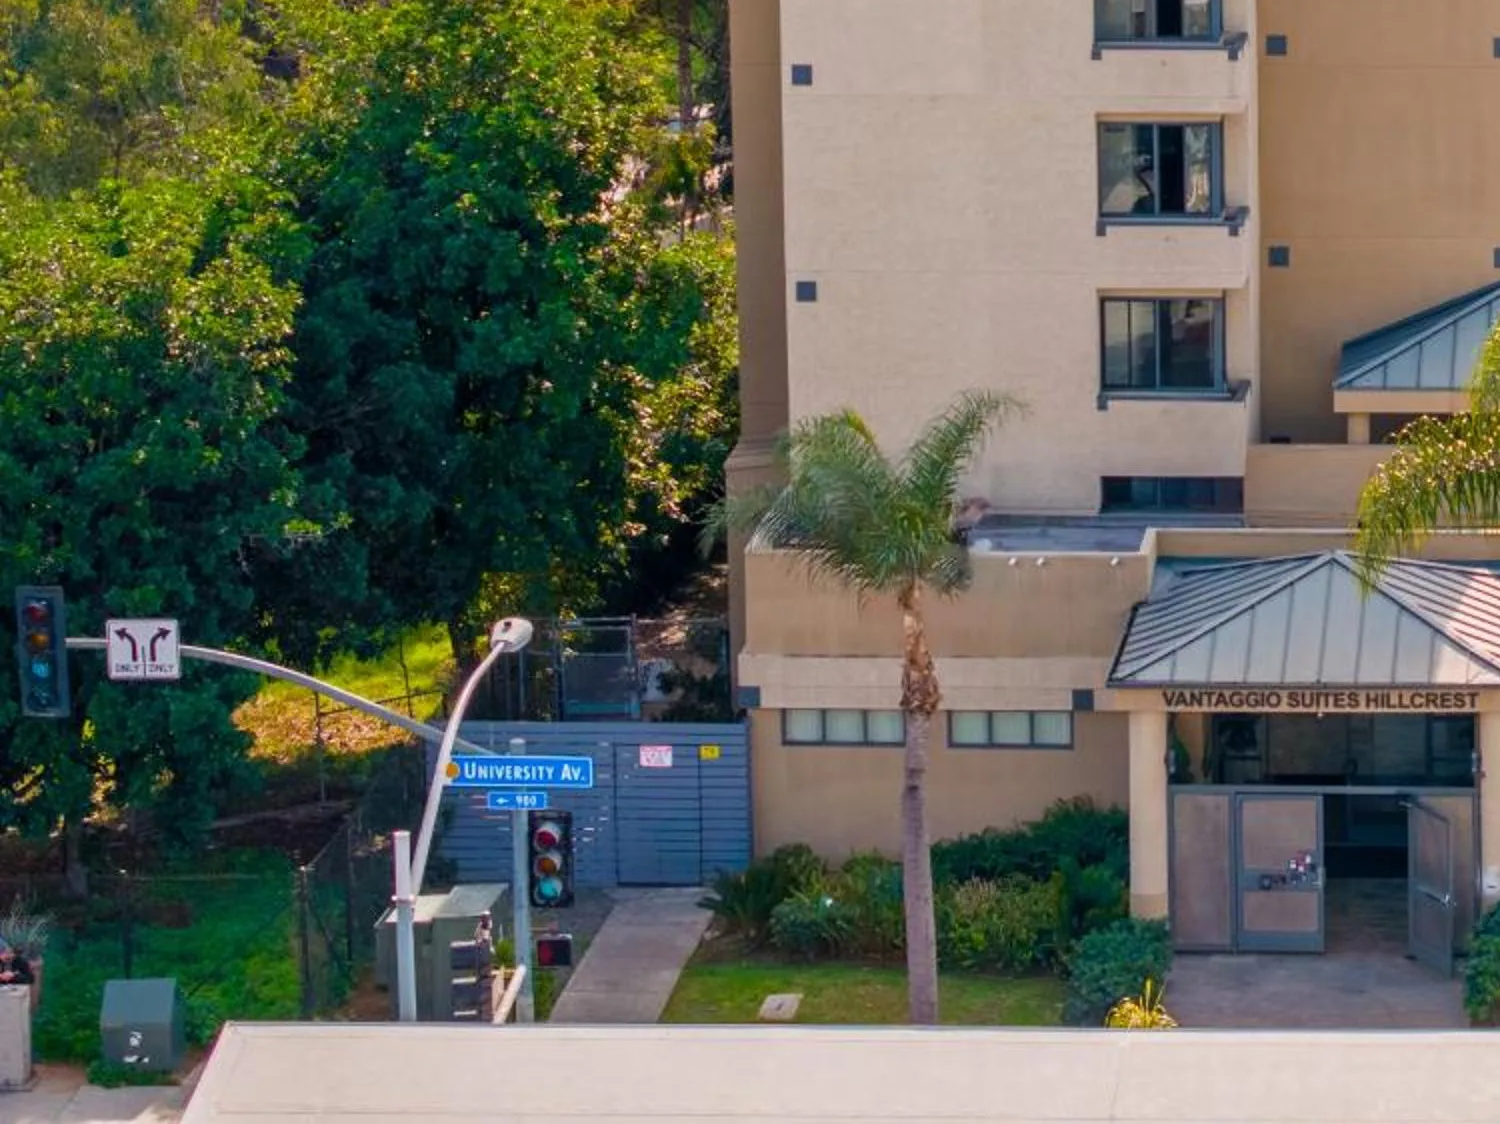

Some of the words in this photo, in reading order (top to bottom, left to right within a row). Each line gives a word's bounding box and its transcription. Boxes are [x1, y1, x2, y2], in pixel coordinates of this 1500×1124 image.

[115, 663, 139, 673] ONLY
[148, 663, 174, 673] ONLY
[1162, 691, 1281, 709] VANTAGGIO
[1286, 691, 1361, 709] SUITES
[1365, 691, 1479, 709] HILLCREST
[463, 761, 554, 781] UNIVERSITY
[560, 763, 586, 782] AV.
